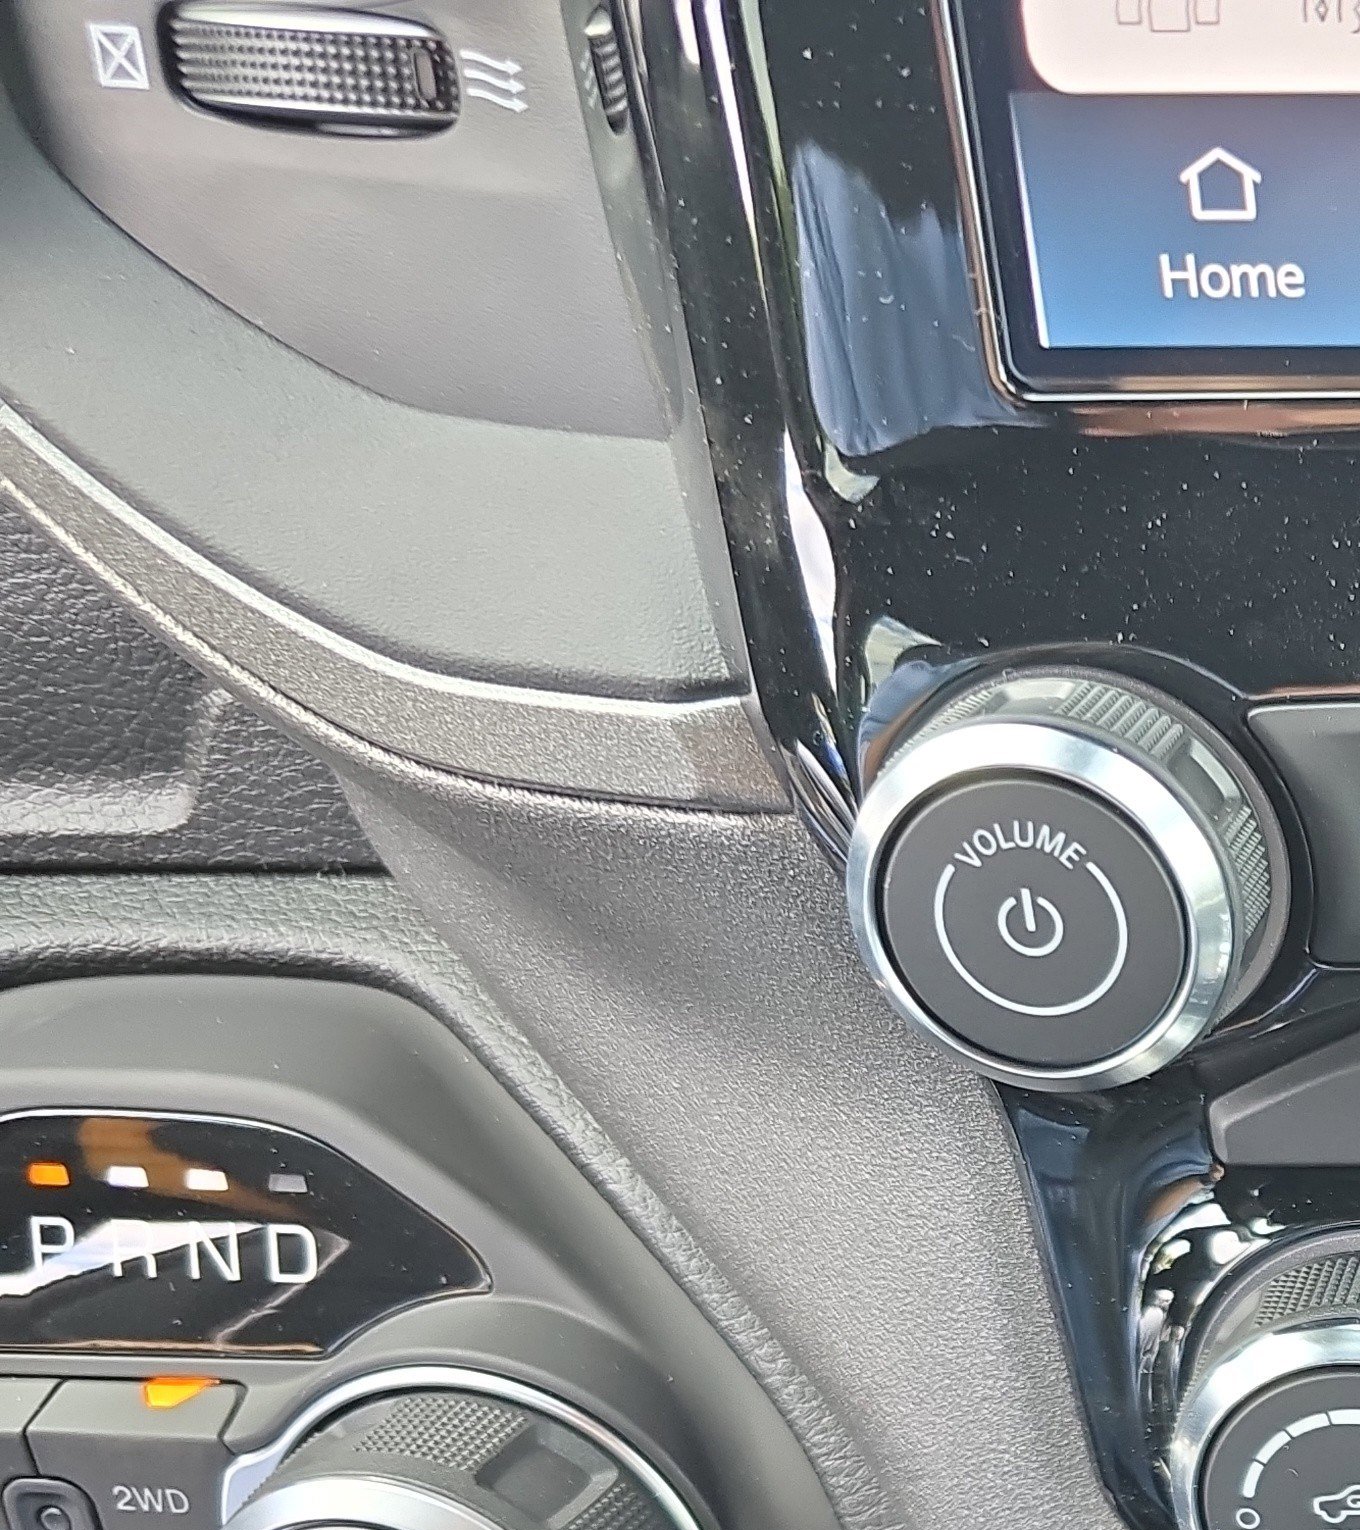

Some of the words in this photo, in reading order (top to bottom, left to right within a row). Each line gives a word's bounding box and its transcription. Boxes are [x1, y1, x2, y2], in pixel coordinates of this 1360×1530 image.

[1160, 252, 1305, 299] Home
[954, 820, 1087, 871] VOLUME
[112, 1485, 190, 1514] 2WD
